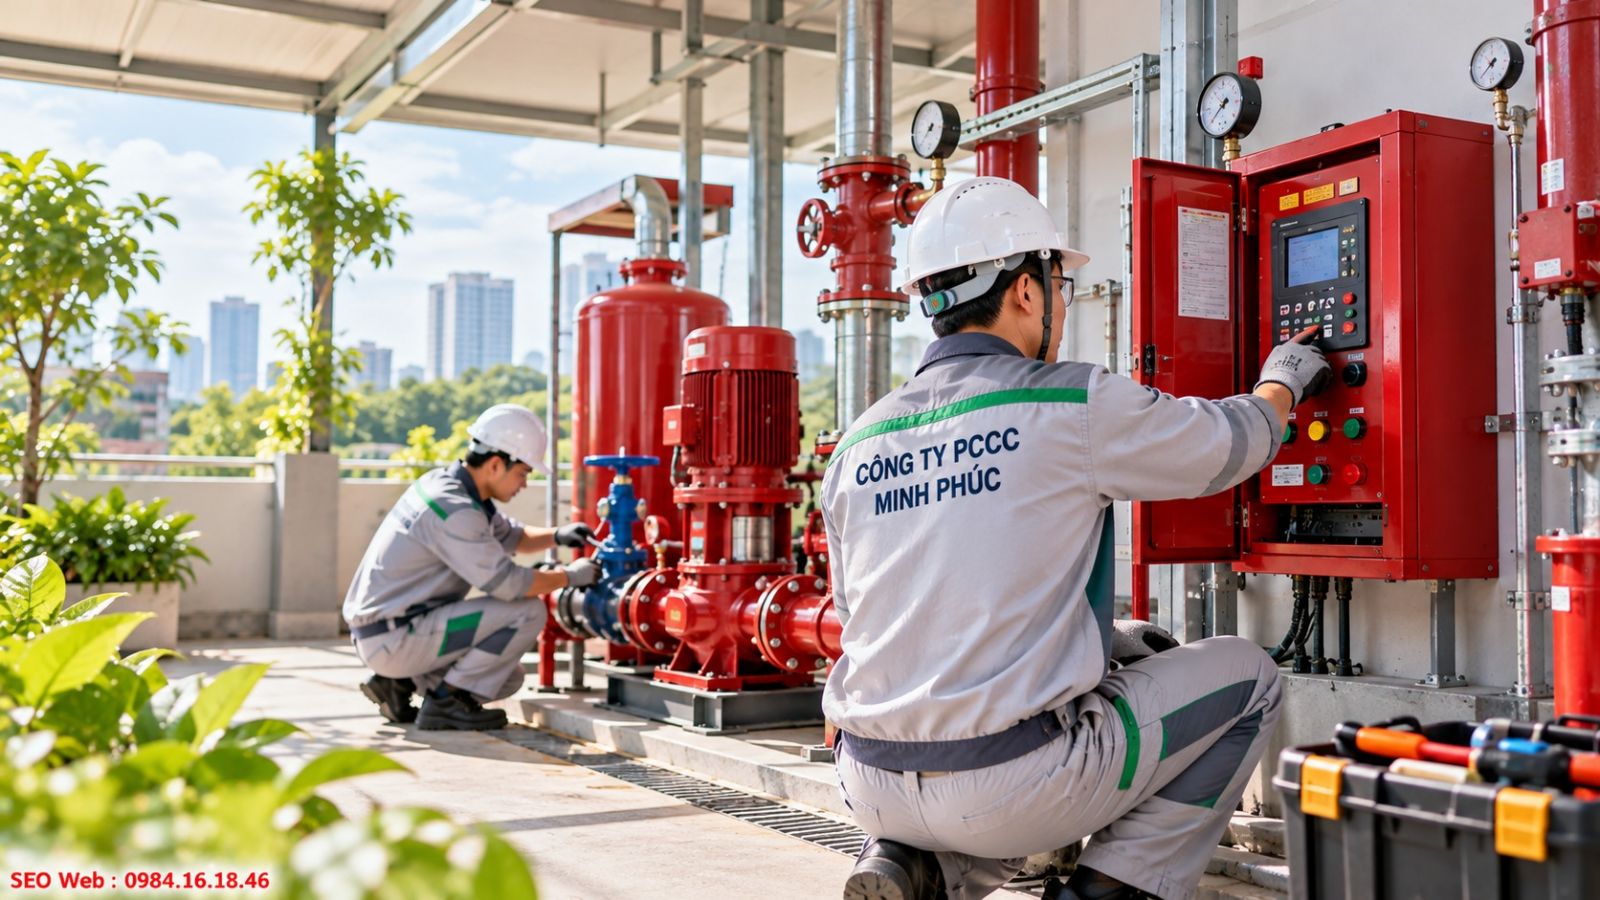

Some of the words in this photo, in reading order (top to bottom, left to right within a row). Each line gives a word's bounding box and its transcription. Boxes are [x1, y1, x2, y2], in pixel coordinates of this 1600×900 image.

[855, 454, 914, 486] CÔNG
[919, 443, 947, 471] TY
[953, 427, 1020, 464] PCCC
[874, 482, 929, 516] MINH
[936, 464, 1002, 502] PHÚC
